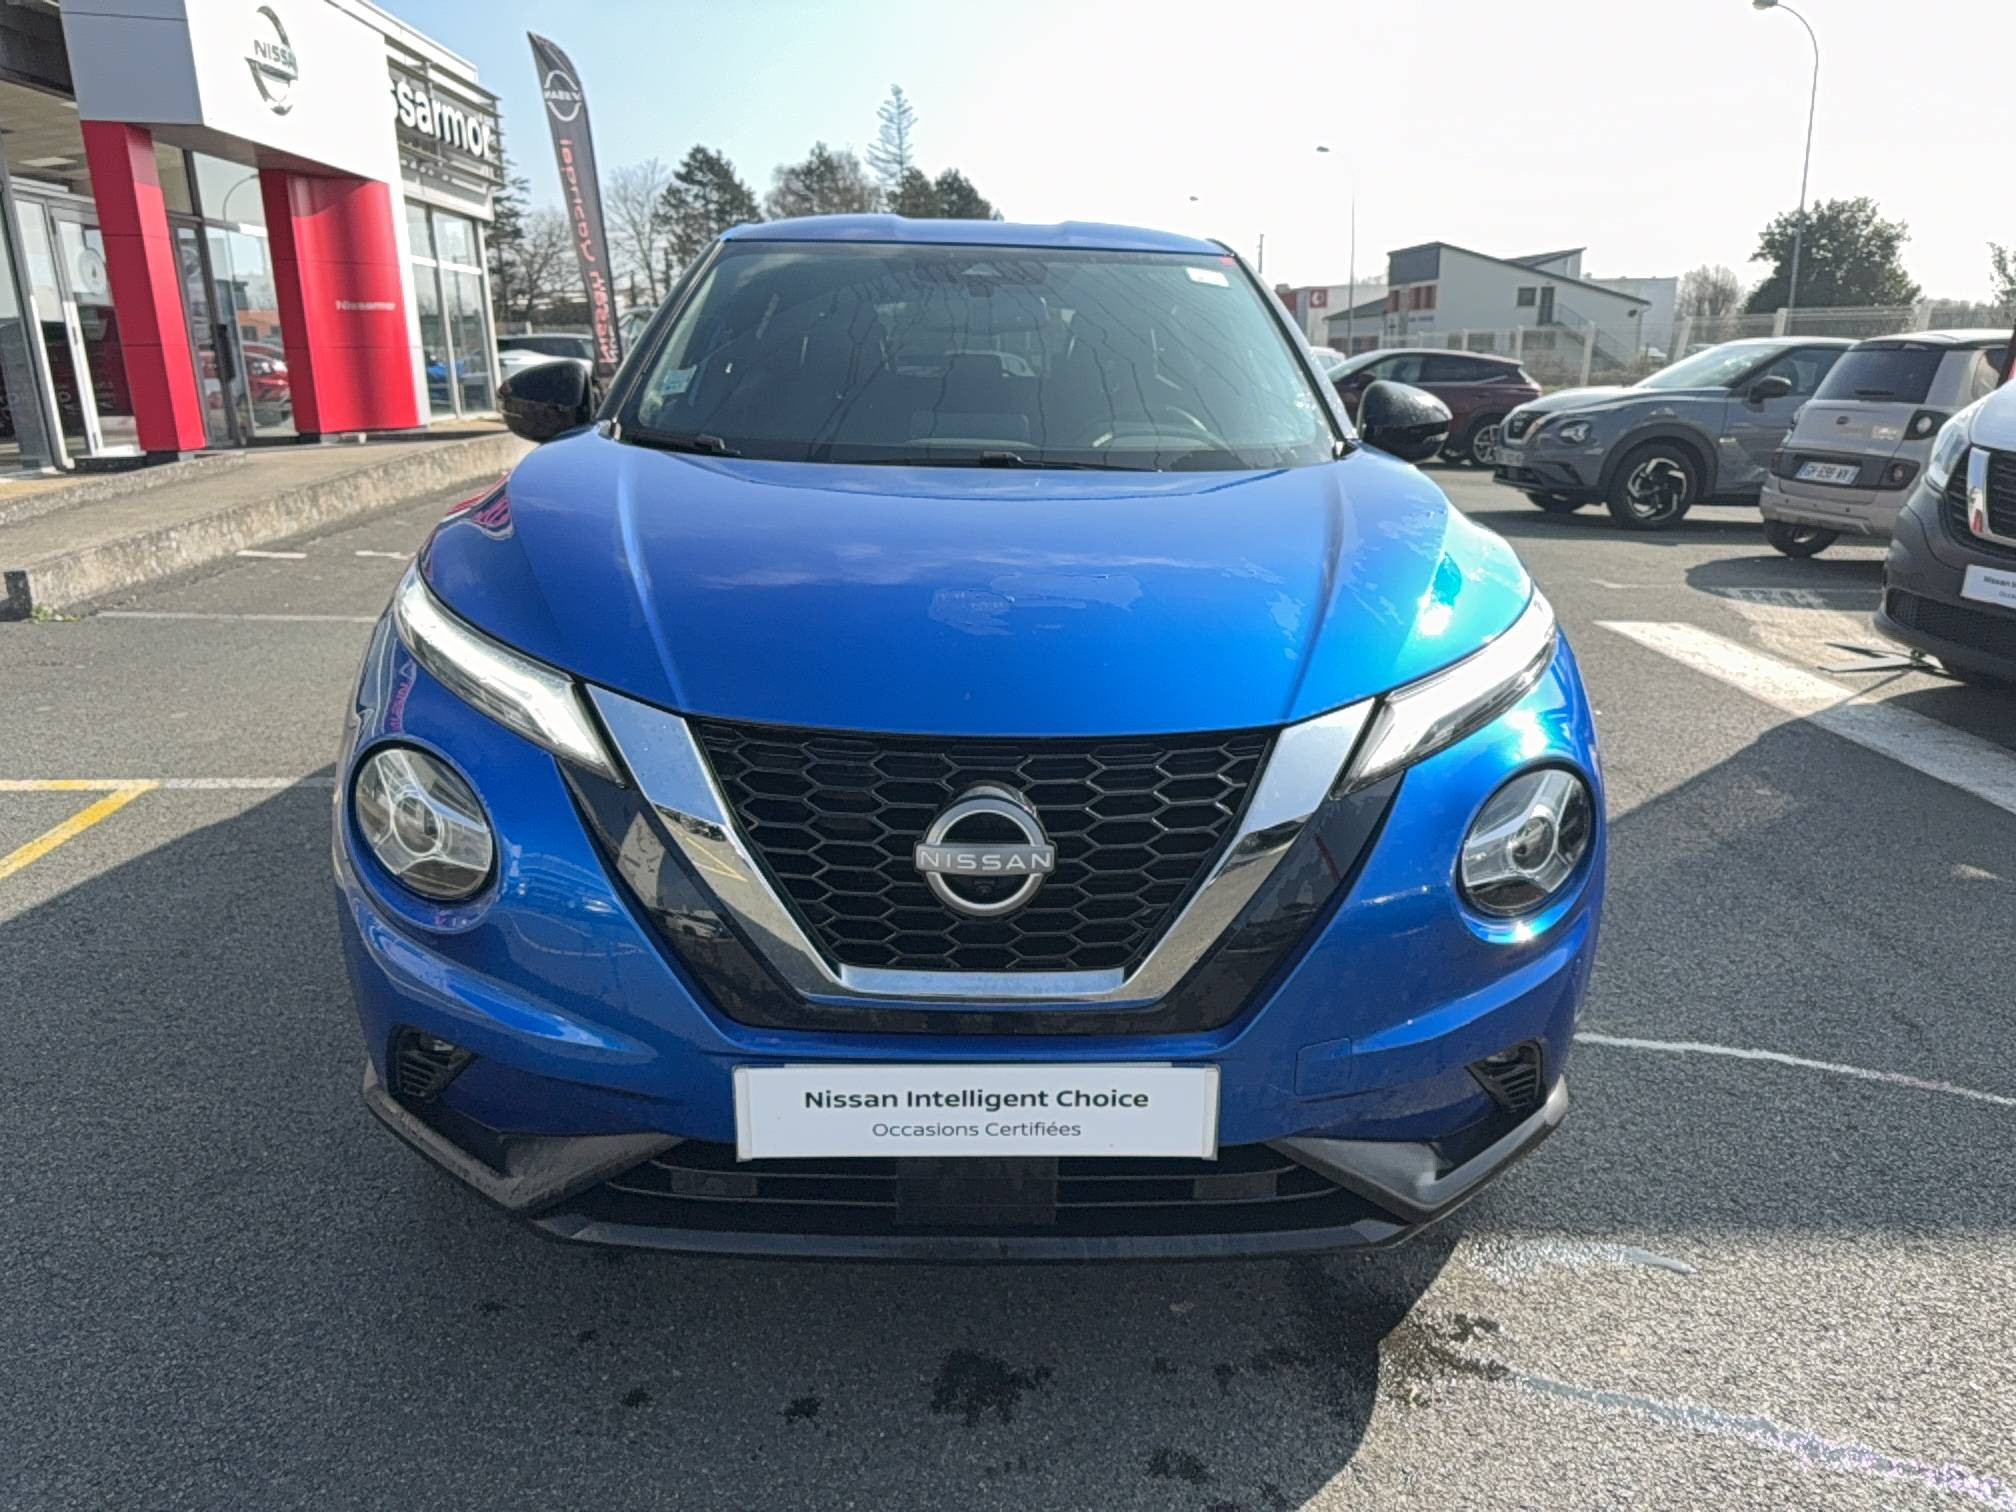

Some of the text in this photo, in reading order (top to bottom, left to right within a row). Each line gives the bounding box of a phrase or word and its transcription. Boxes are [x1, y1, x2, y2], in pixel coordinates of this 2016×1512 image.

[391, 79, 492, 161] sarmor
[919, 850, 1050, 871] NISSAN
[804, 1089, 1150, 1112] Nissan Intelligent Choice
[872, 1120, 1082, 1138] Occasions Certifiées
